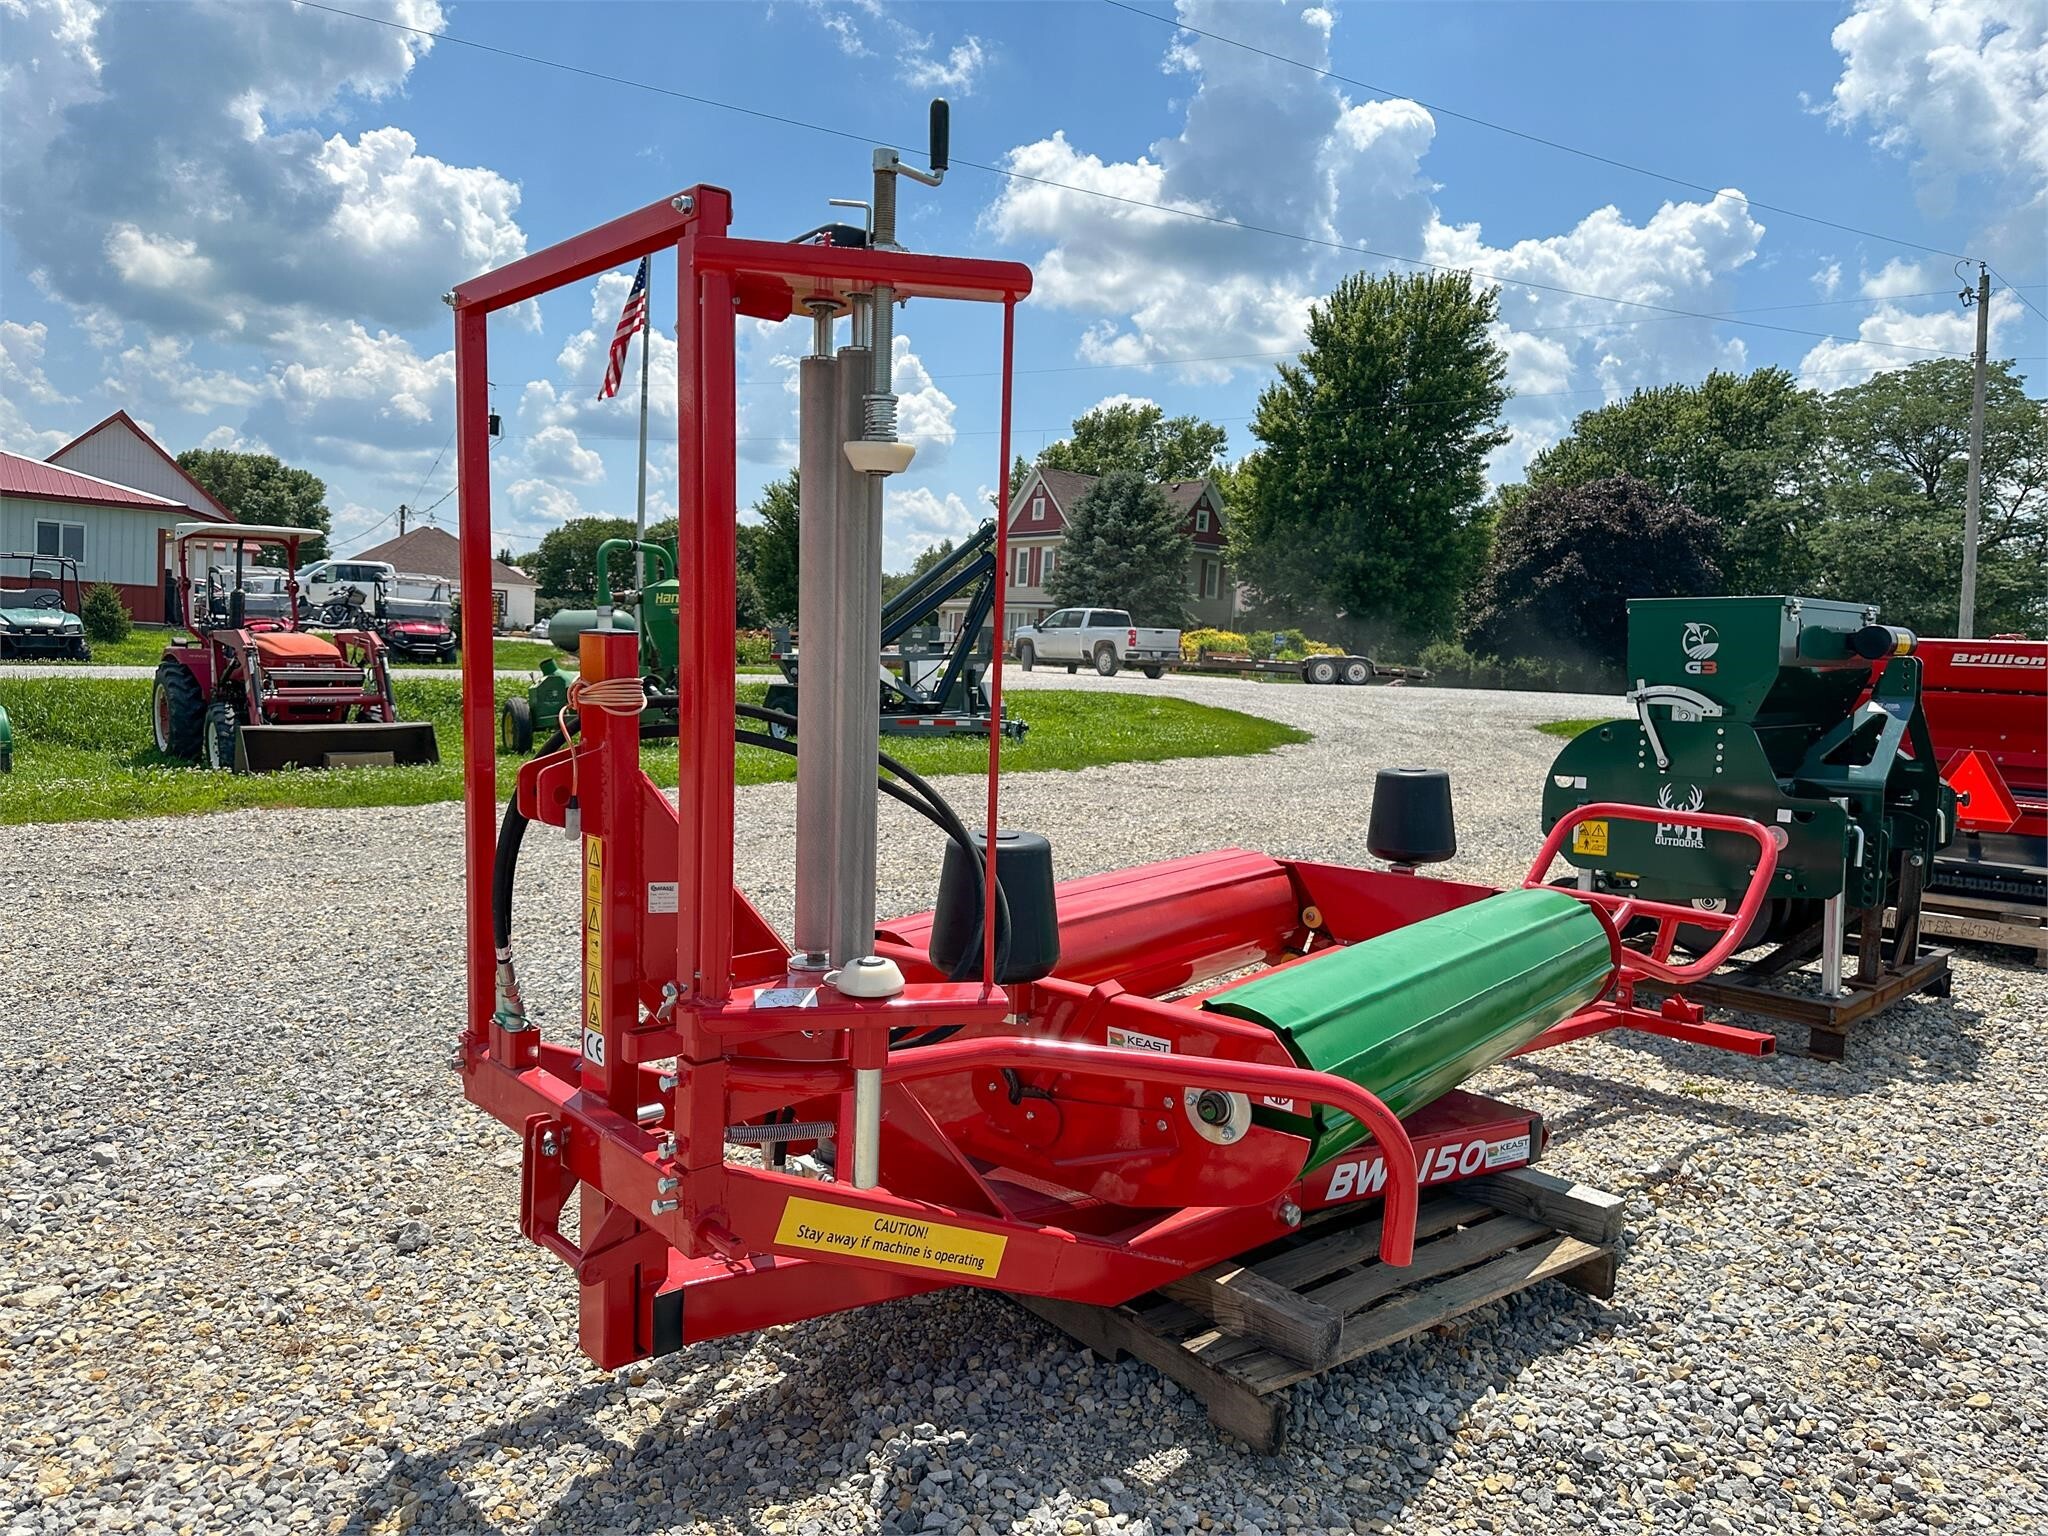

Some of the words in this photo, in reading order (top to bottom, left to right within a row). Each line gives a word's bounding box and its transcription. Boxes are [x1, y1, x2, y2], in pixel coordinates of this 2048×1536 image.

[1685, 661, 1718, 675] G3
[1951, 653, 2047, 666] Brillion
[1655, 836, 1704, 849] OUTDOORS
[586, 1033, 603, 1063] CE
[1127, 1035, 1169, 1053] KEAST
[1500, 1138, 1529, 1152] KEAST
[1325, 1158, 1388, 1201] BW
[1417, 1140, 1487, 1183] 150
[874, 1218, 930, 1240] CAUTION!
[797, 1224, 825, 1244] Stay
[826, 1232, 859, 1250] away
[860, 1235, 873, 1251] if
[872, 1239, 921, 1258] machine
[922, 1245, 932, 1260] is
[934, 1251, 985, 1271] operating
